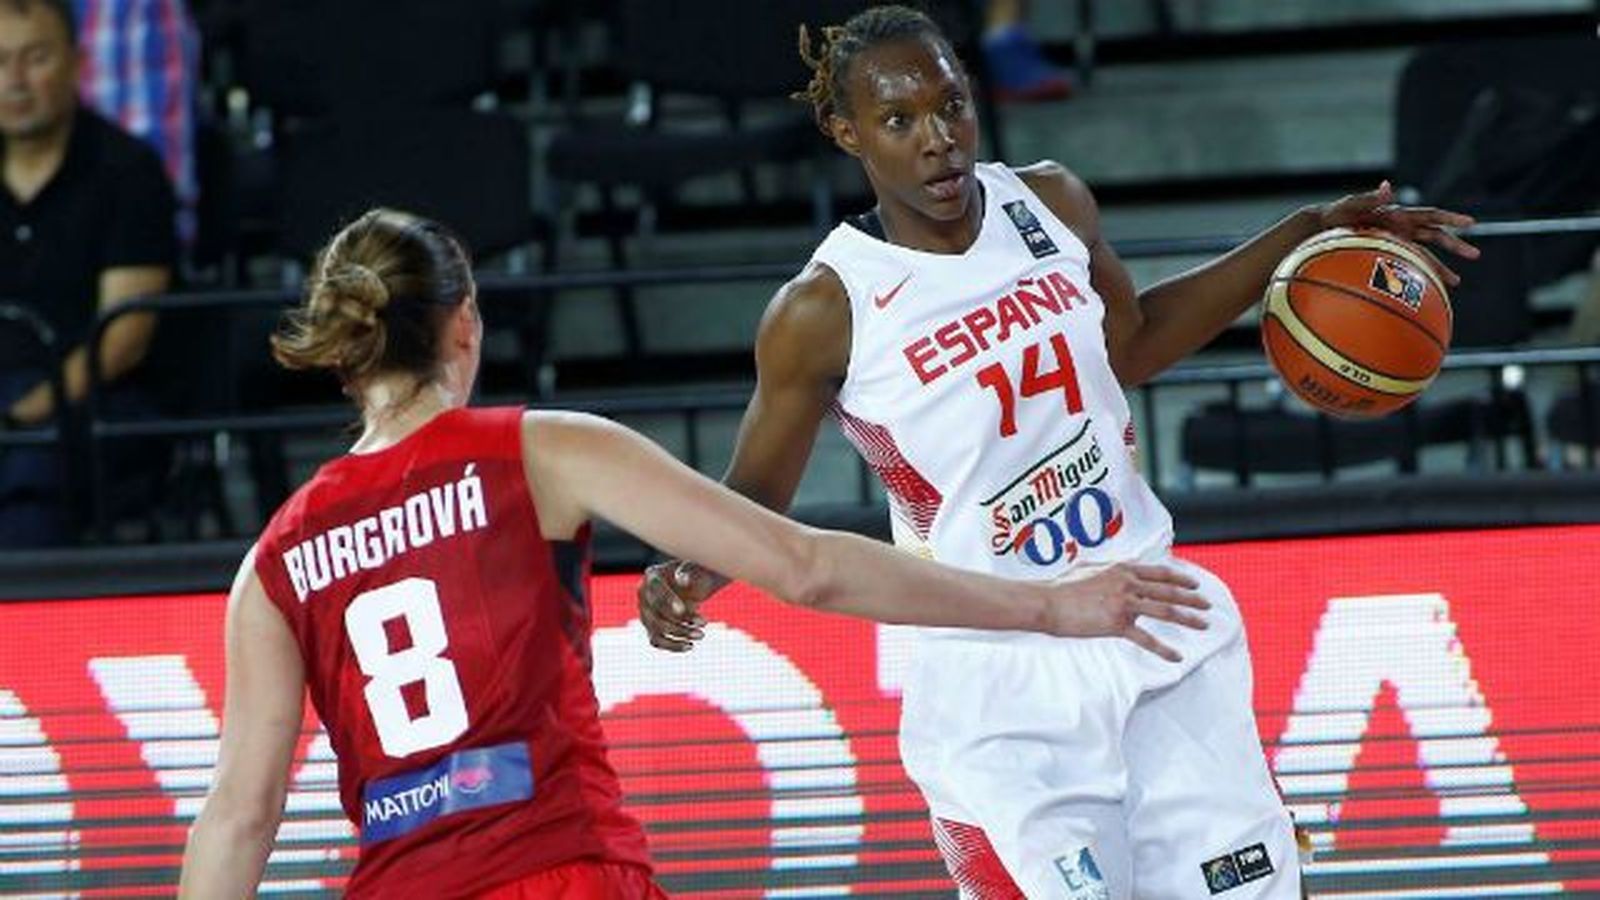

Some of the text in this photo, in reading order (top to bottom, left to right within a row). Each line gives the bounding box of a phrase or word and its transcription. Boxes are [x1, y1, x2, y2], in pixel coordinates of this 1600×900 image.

[903, 271, 1087, 385] ESPAÑA
[976, 332, 1083, 438] 14
[283, 462, 488, 603] BURGROVÁ
[344, 577, 469, 759] 8
[365, 773, 450, 825] MATTONI
